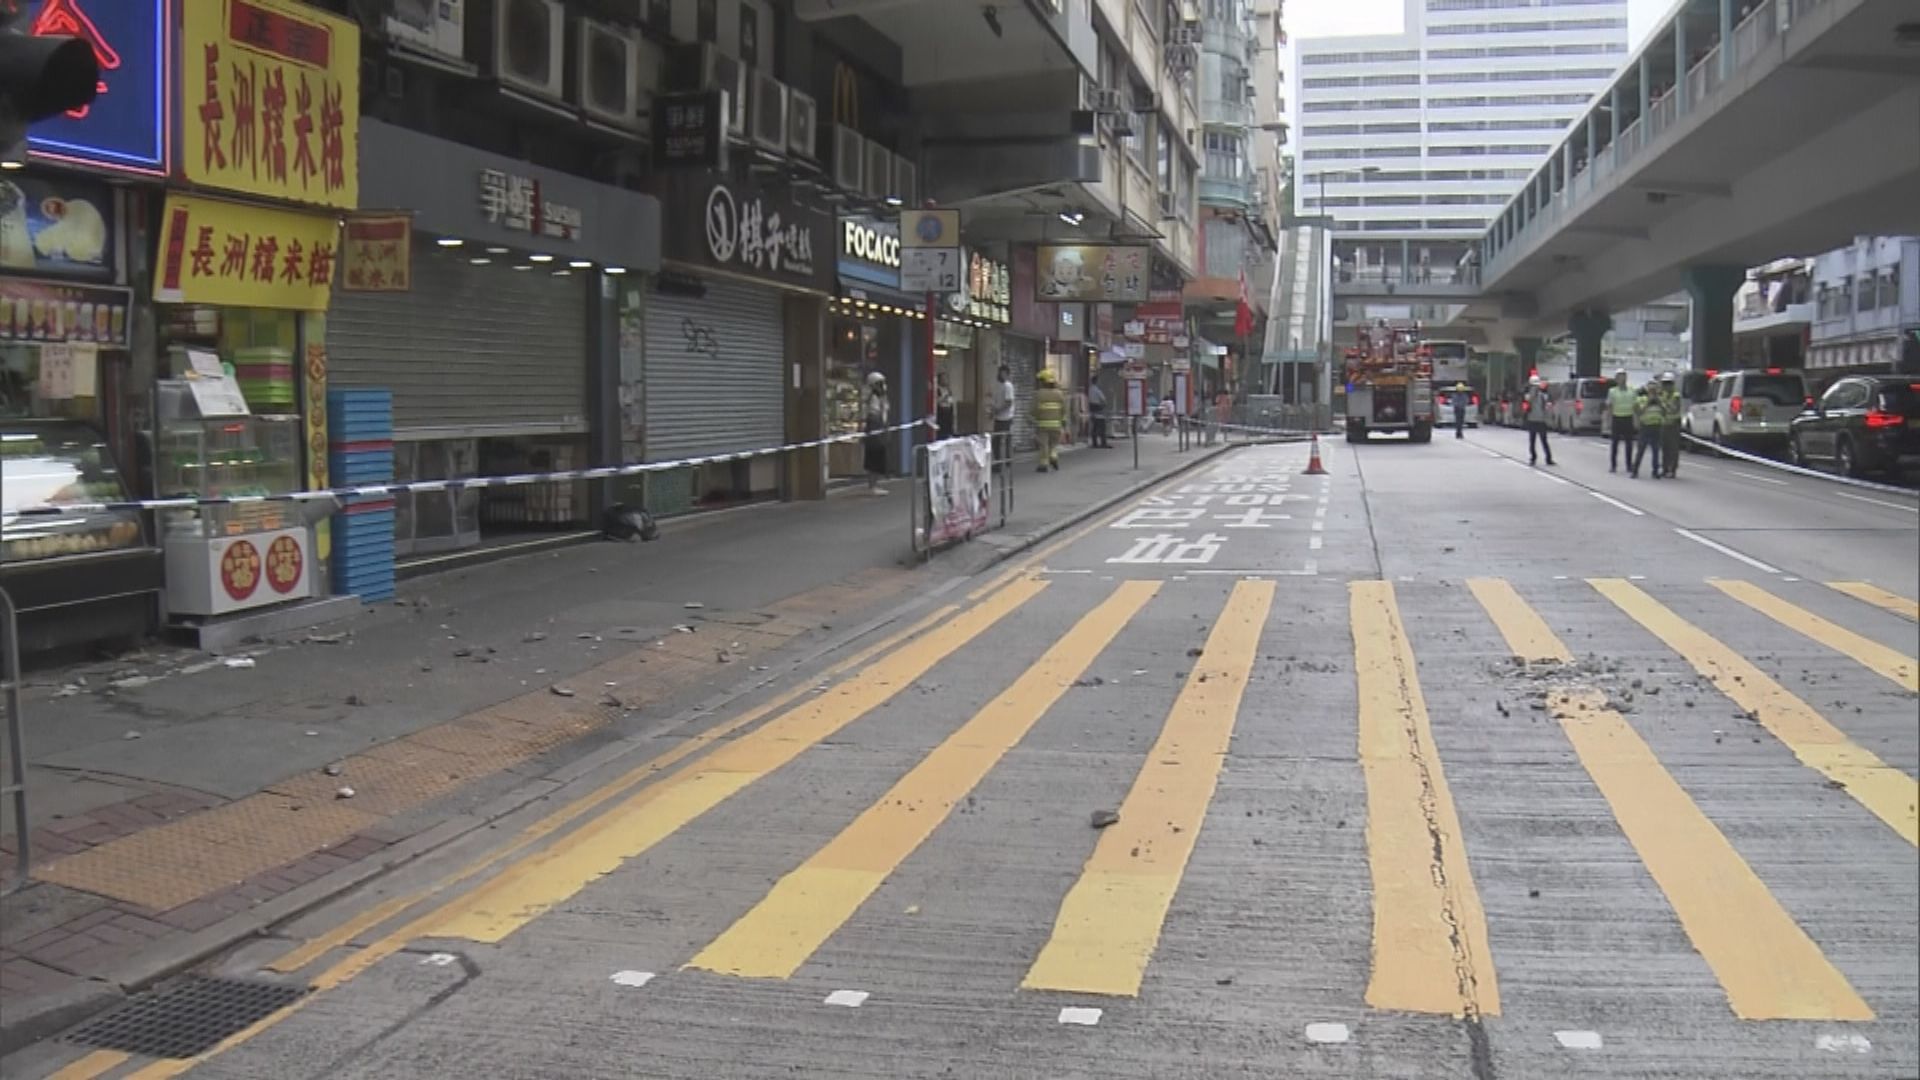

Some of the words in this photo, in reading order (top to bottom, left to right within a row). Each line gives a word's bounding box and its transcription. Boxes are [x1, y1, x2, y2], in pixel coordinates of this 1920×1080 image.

[845, 220, 901, 268] FOCACC
[937, 251, 948, 267] 7
[940, 272, 956, 288] 12
[1138, 493, 1312, 506] STOP
[1109, 508, 1292, 529] 巴士
[1105, 533, 1229, 563] 站
